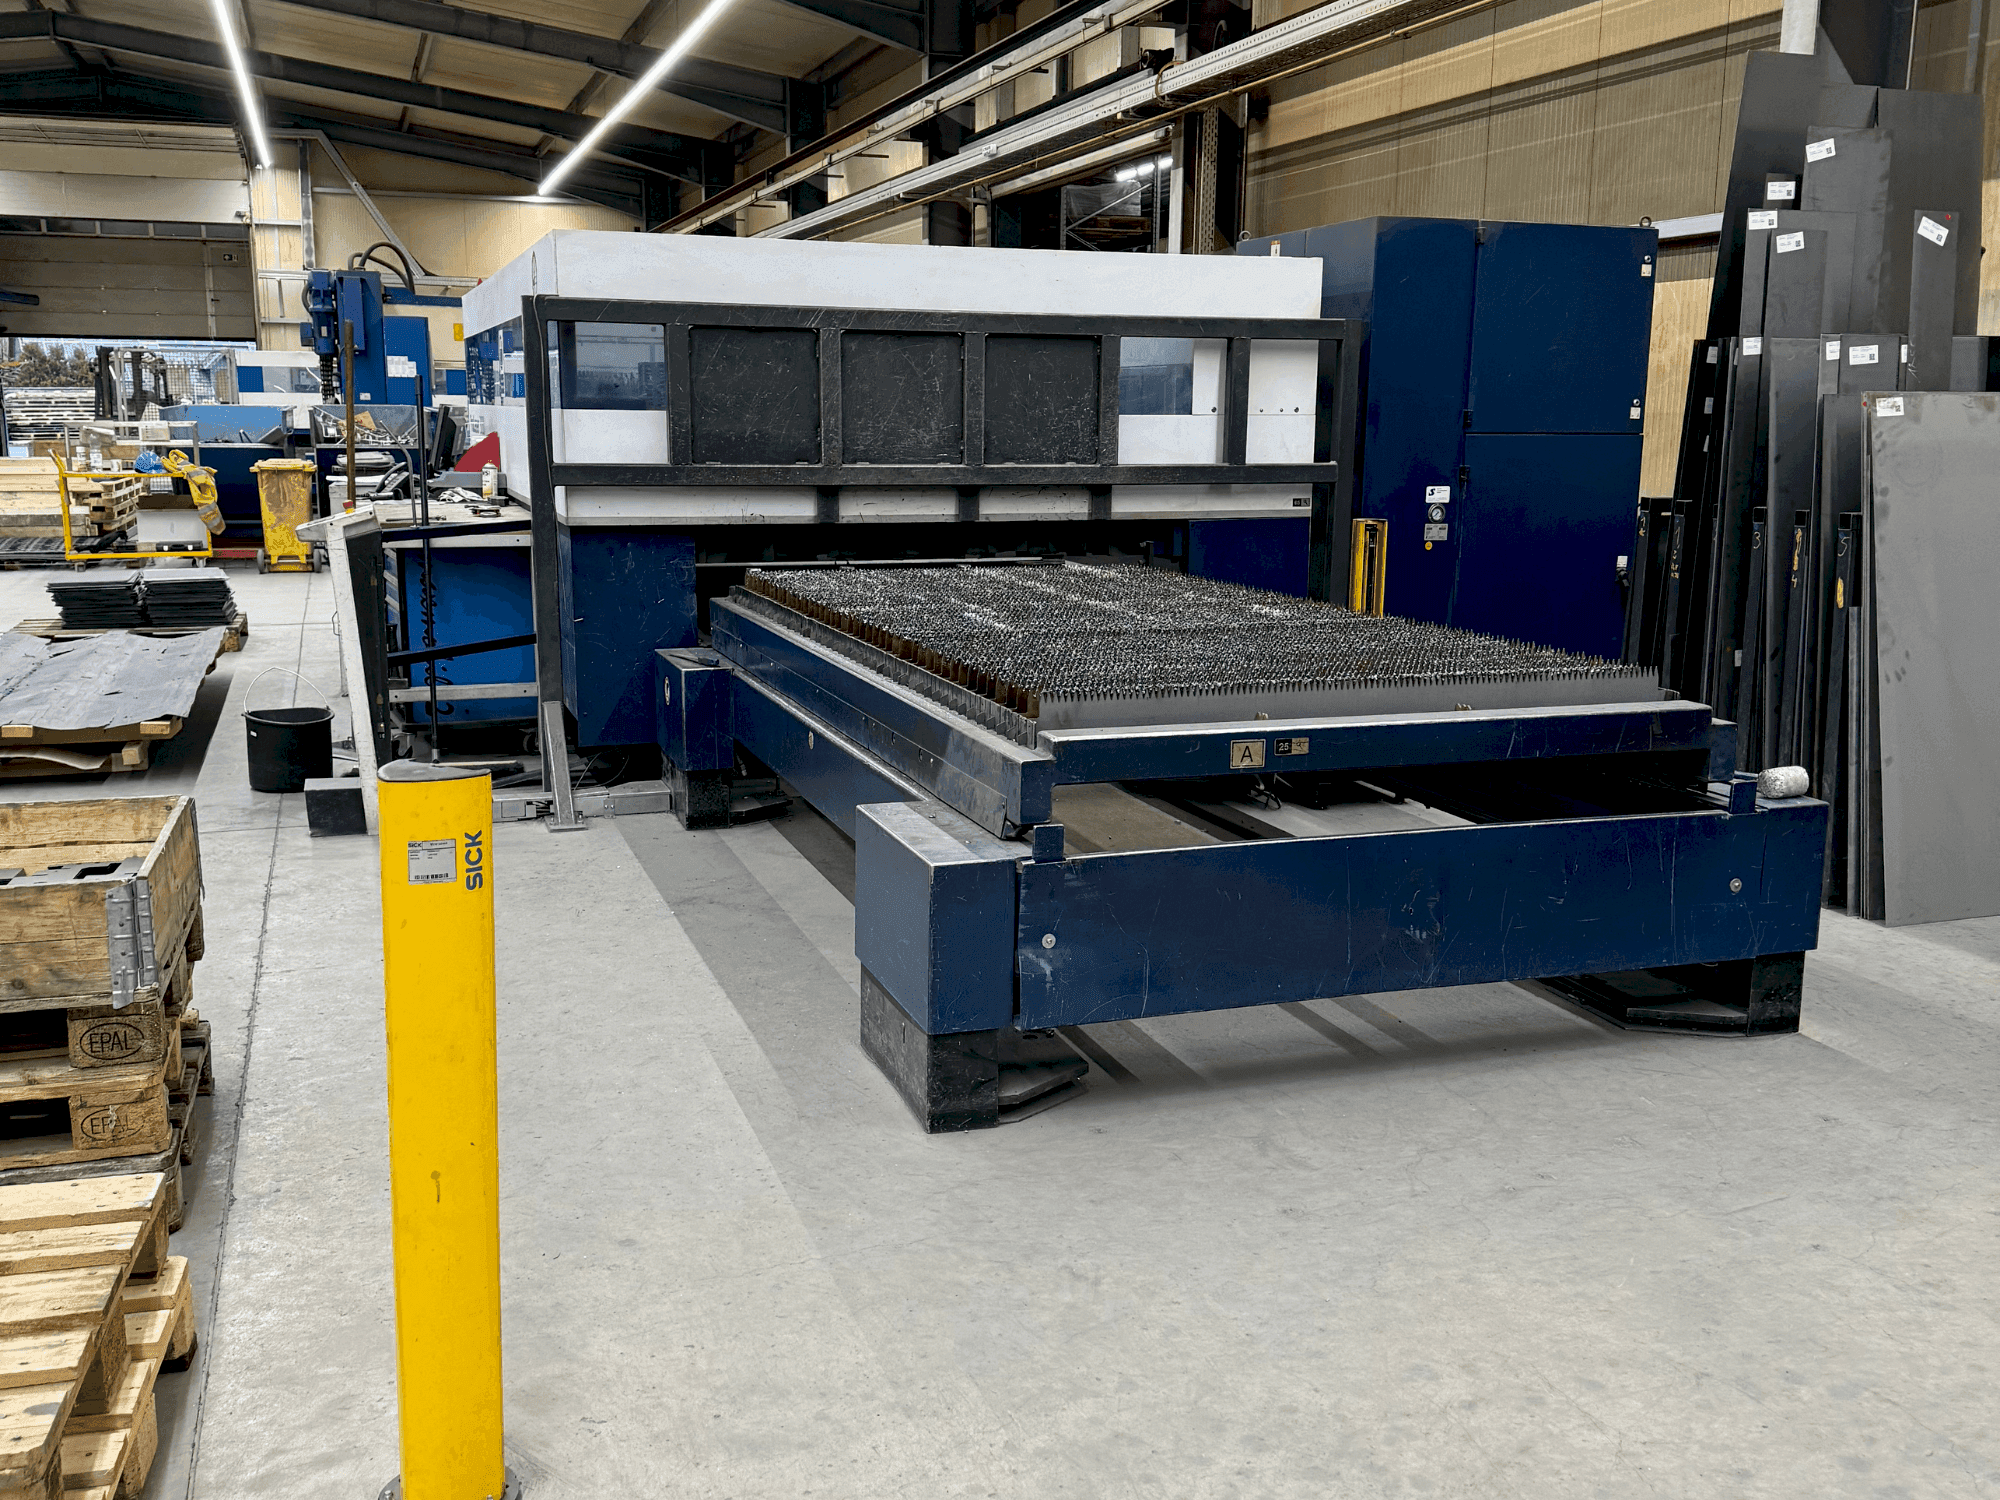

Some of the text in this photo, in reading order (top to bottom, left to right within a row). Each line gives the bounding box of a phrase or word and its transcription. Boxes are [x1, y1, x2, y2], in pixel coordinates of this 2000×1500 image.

[1753, 531, 1761, 549] 3
[1837, 536, 1851, 557] 5
[1240, 745, 1254, 763] A
[1278, 742, 1290, 752] 25
[464, 829, 484, 891] SICK
[89, 1030, 133, 1054] EPAL
